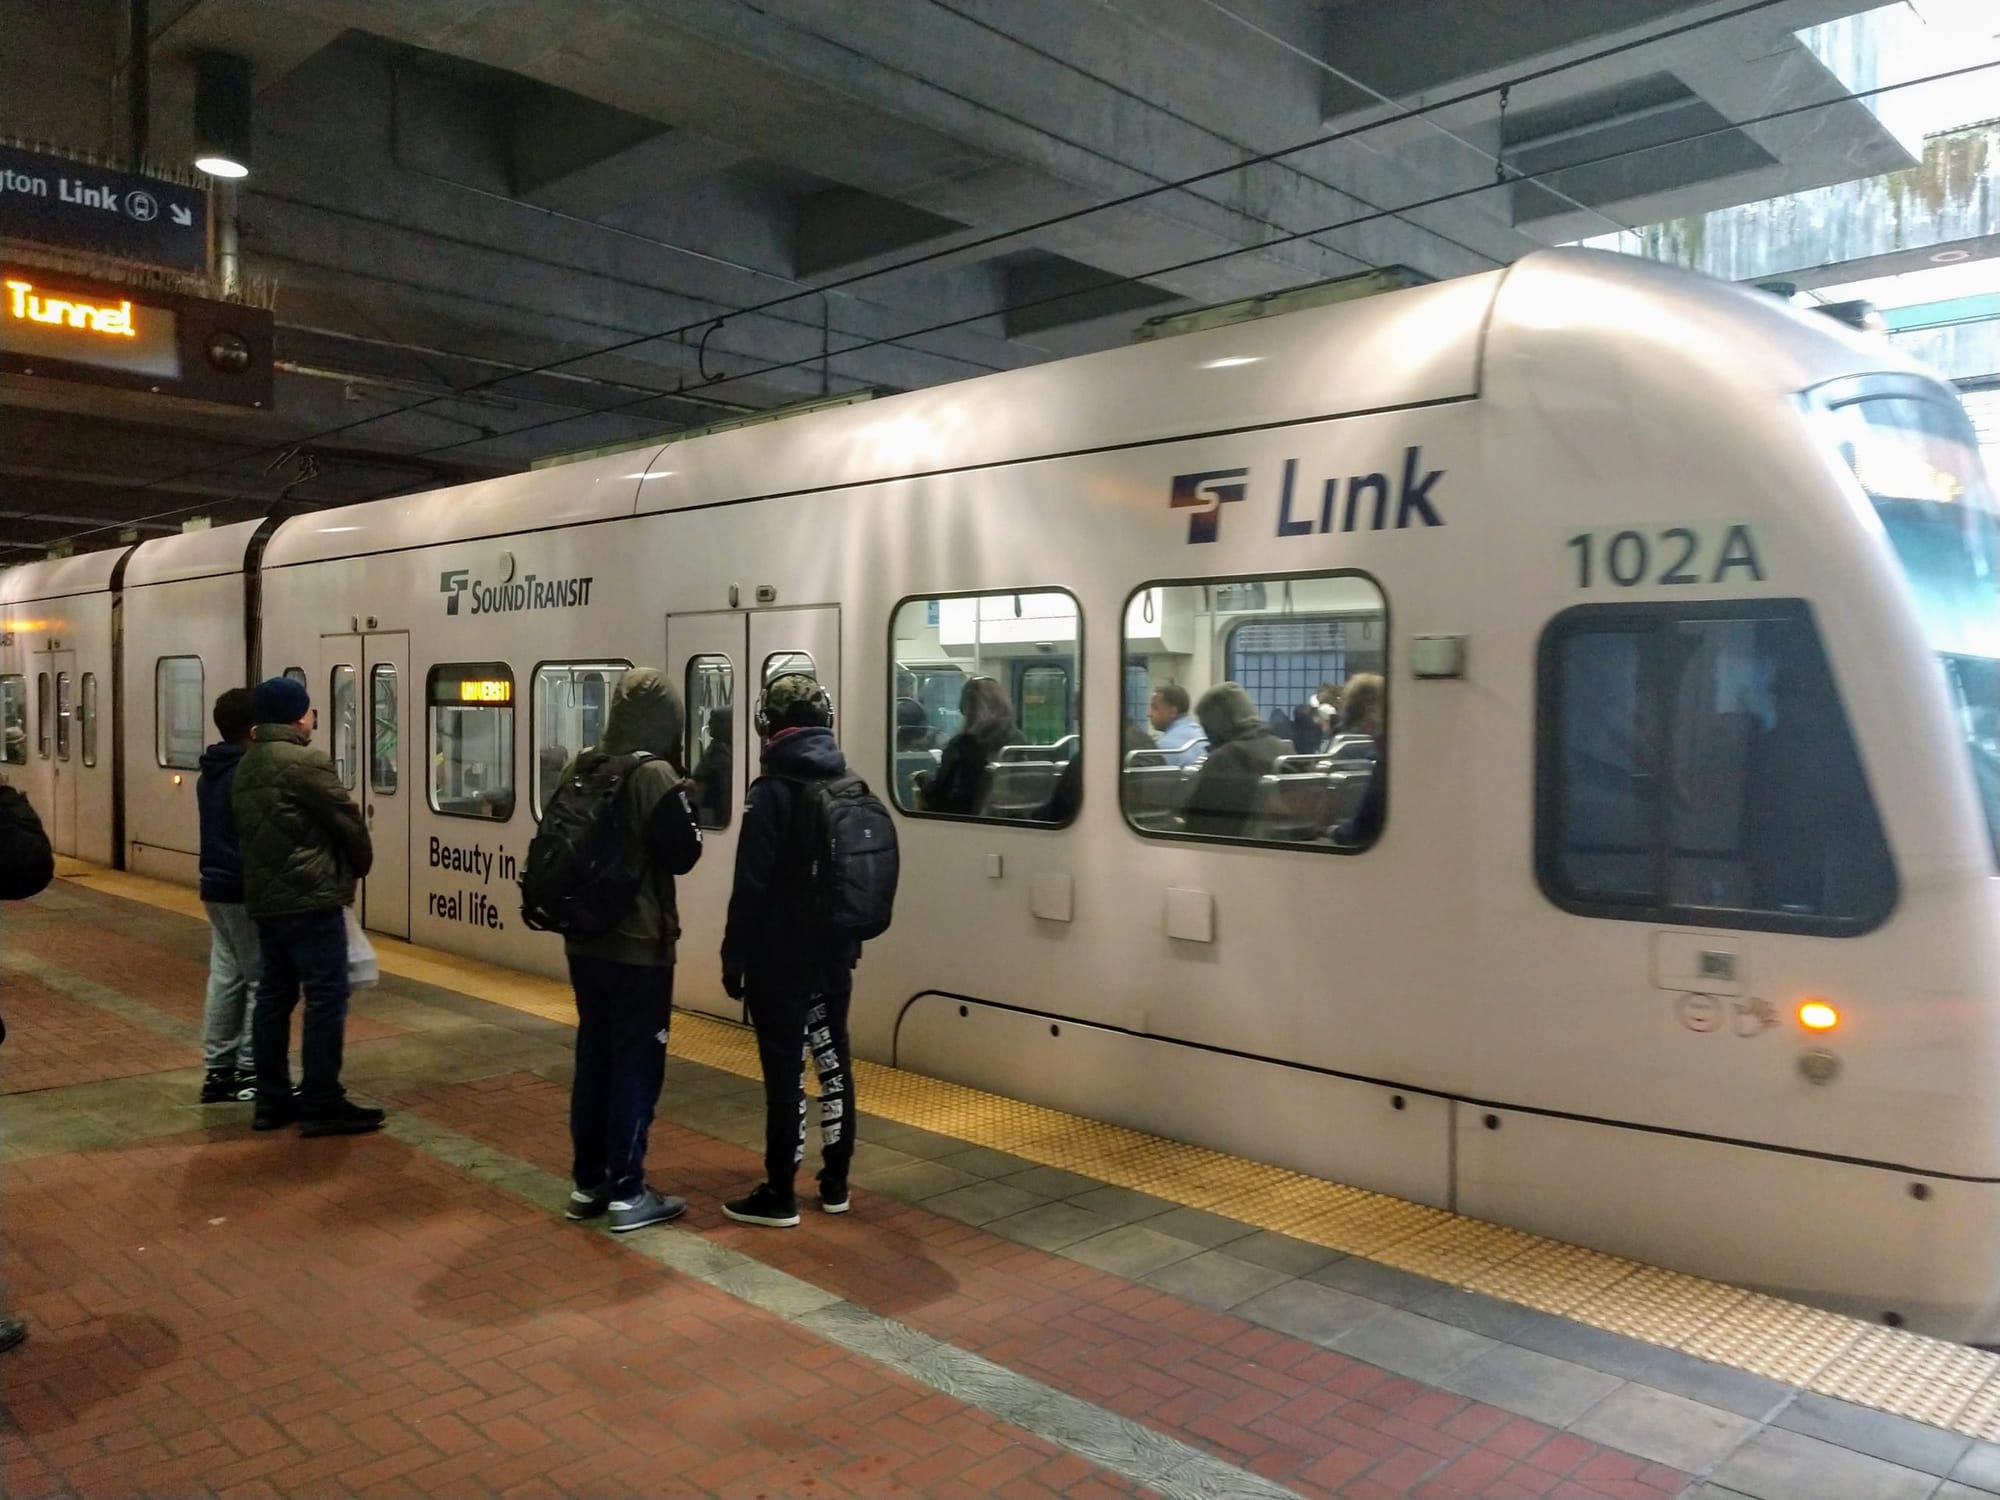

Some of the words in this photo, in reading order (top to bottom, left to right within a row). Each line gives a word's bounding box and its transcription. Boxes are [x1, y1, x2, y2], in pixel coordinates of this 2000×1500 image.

[59, 178, 119, 212] Link
[5, 280, 136, 338] Tunnel
[1275, 446, 1448, 537] Link
[1567, 524, 1768, 589] 102A
[430, 835, 493, 885] Beauty
[499, 844, 516, 880] in
[429, 890, 462, 922] real
[469, 891, 504, 930] life.
